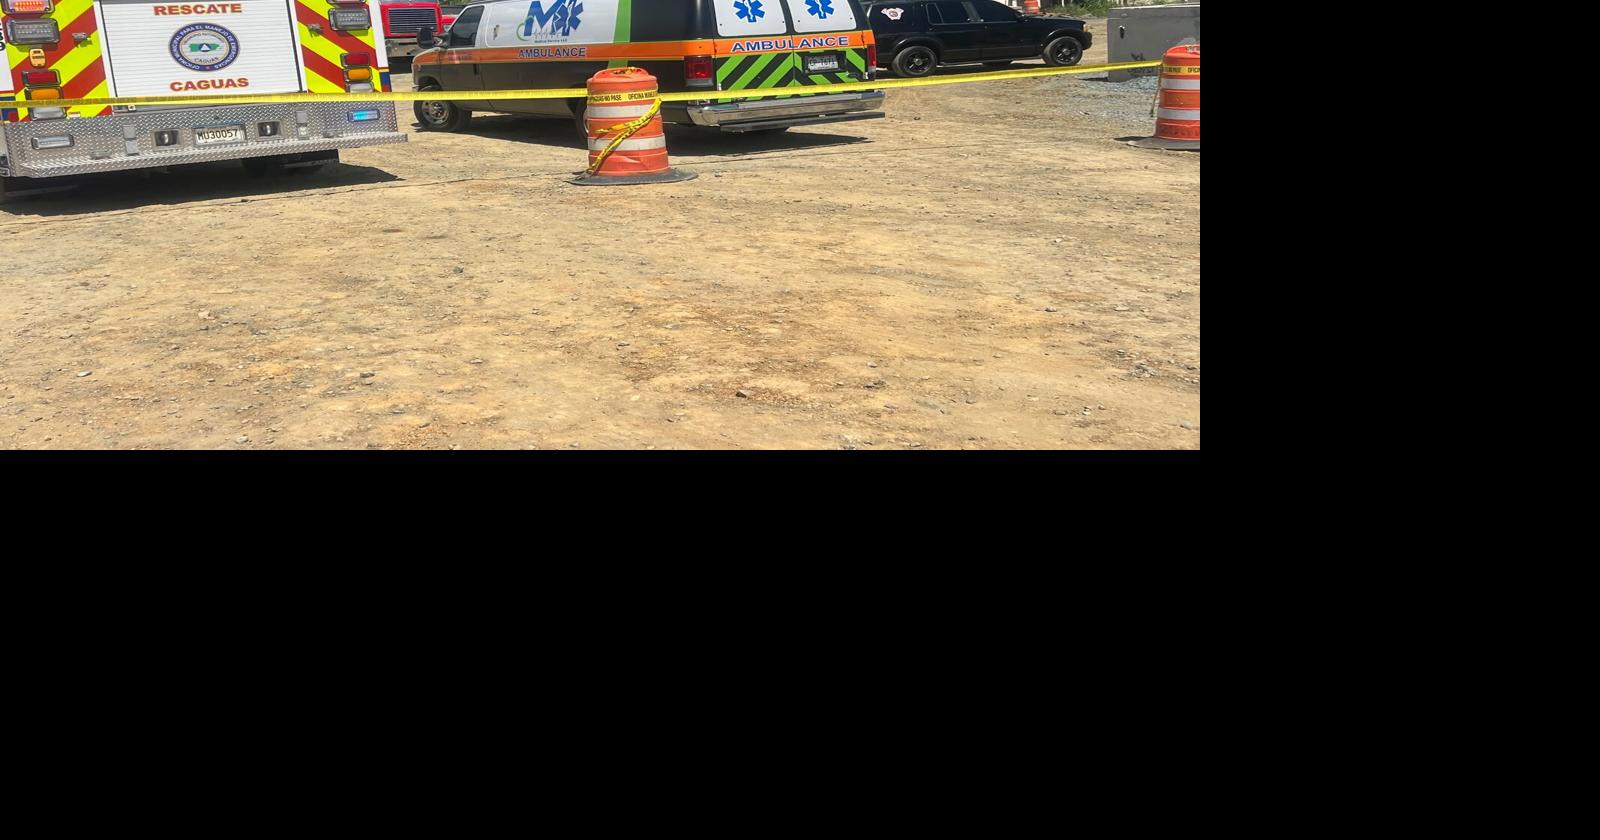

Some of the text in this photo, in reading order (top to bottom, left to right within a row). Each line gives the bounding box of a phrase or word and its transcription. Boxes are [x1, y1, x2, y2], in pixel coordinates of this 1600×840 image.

[153, 3, 242, 16] RESCATE
[731, 36, 849, 52] AMBULANCE
[518, 47, 586, 58] AMBULANCE
[169, 77, 250, 92] CAGUAS
[196, 128, 238, 140] MU30057
